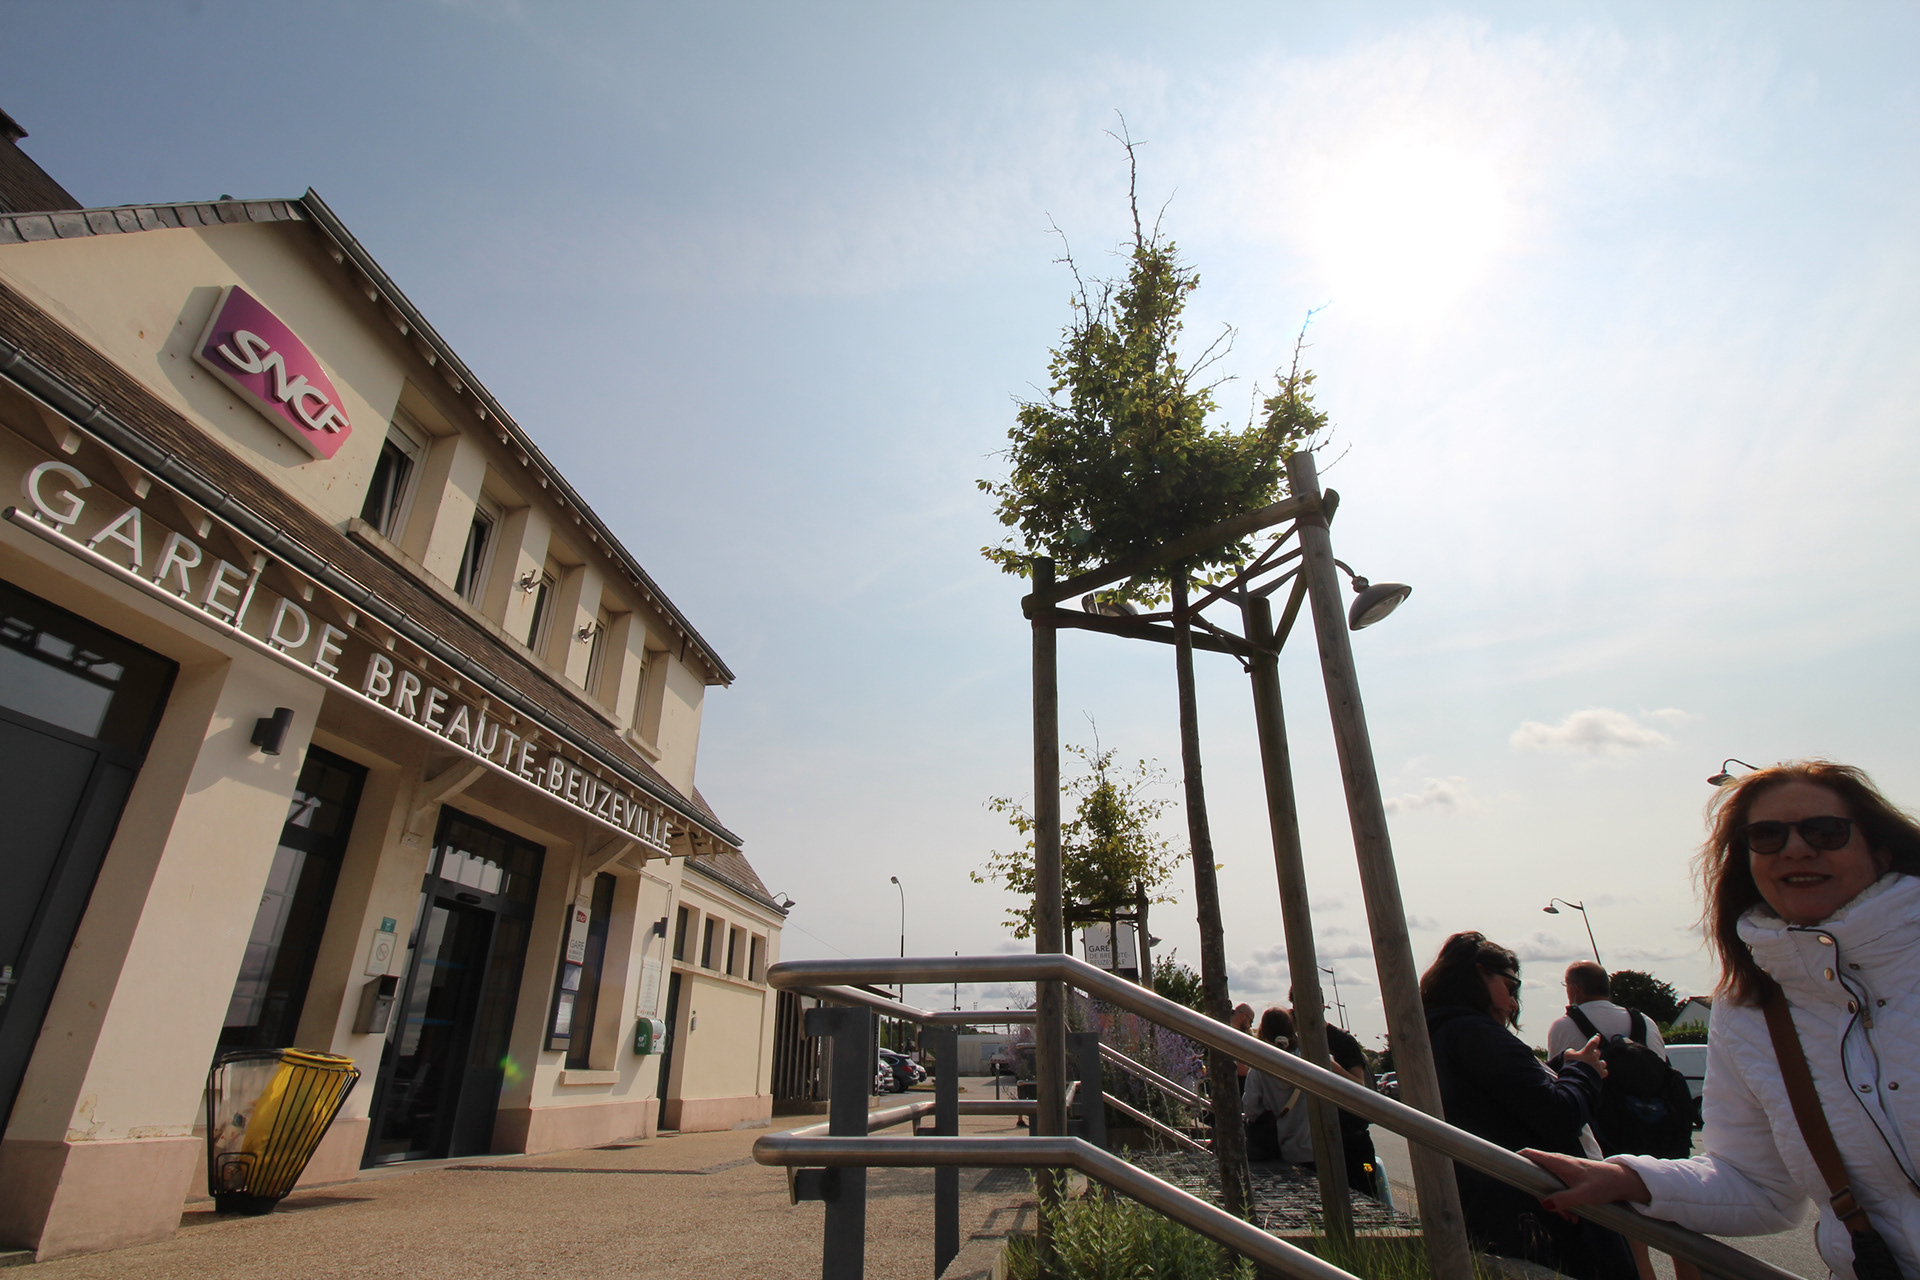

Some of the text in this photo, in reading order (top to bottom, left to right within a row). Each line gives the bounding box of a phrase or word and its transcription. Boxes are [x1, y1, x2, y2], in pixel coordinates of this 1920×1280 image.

[217, 330, 350, 434] SNCF
[22, 461, 673, 849] GARE DE BREAUTE-BEUZEVILLE
[570, 939, 585, 950] GARE
